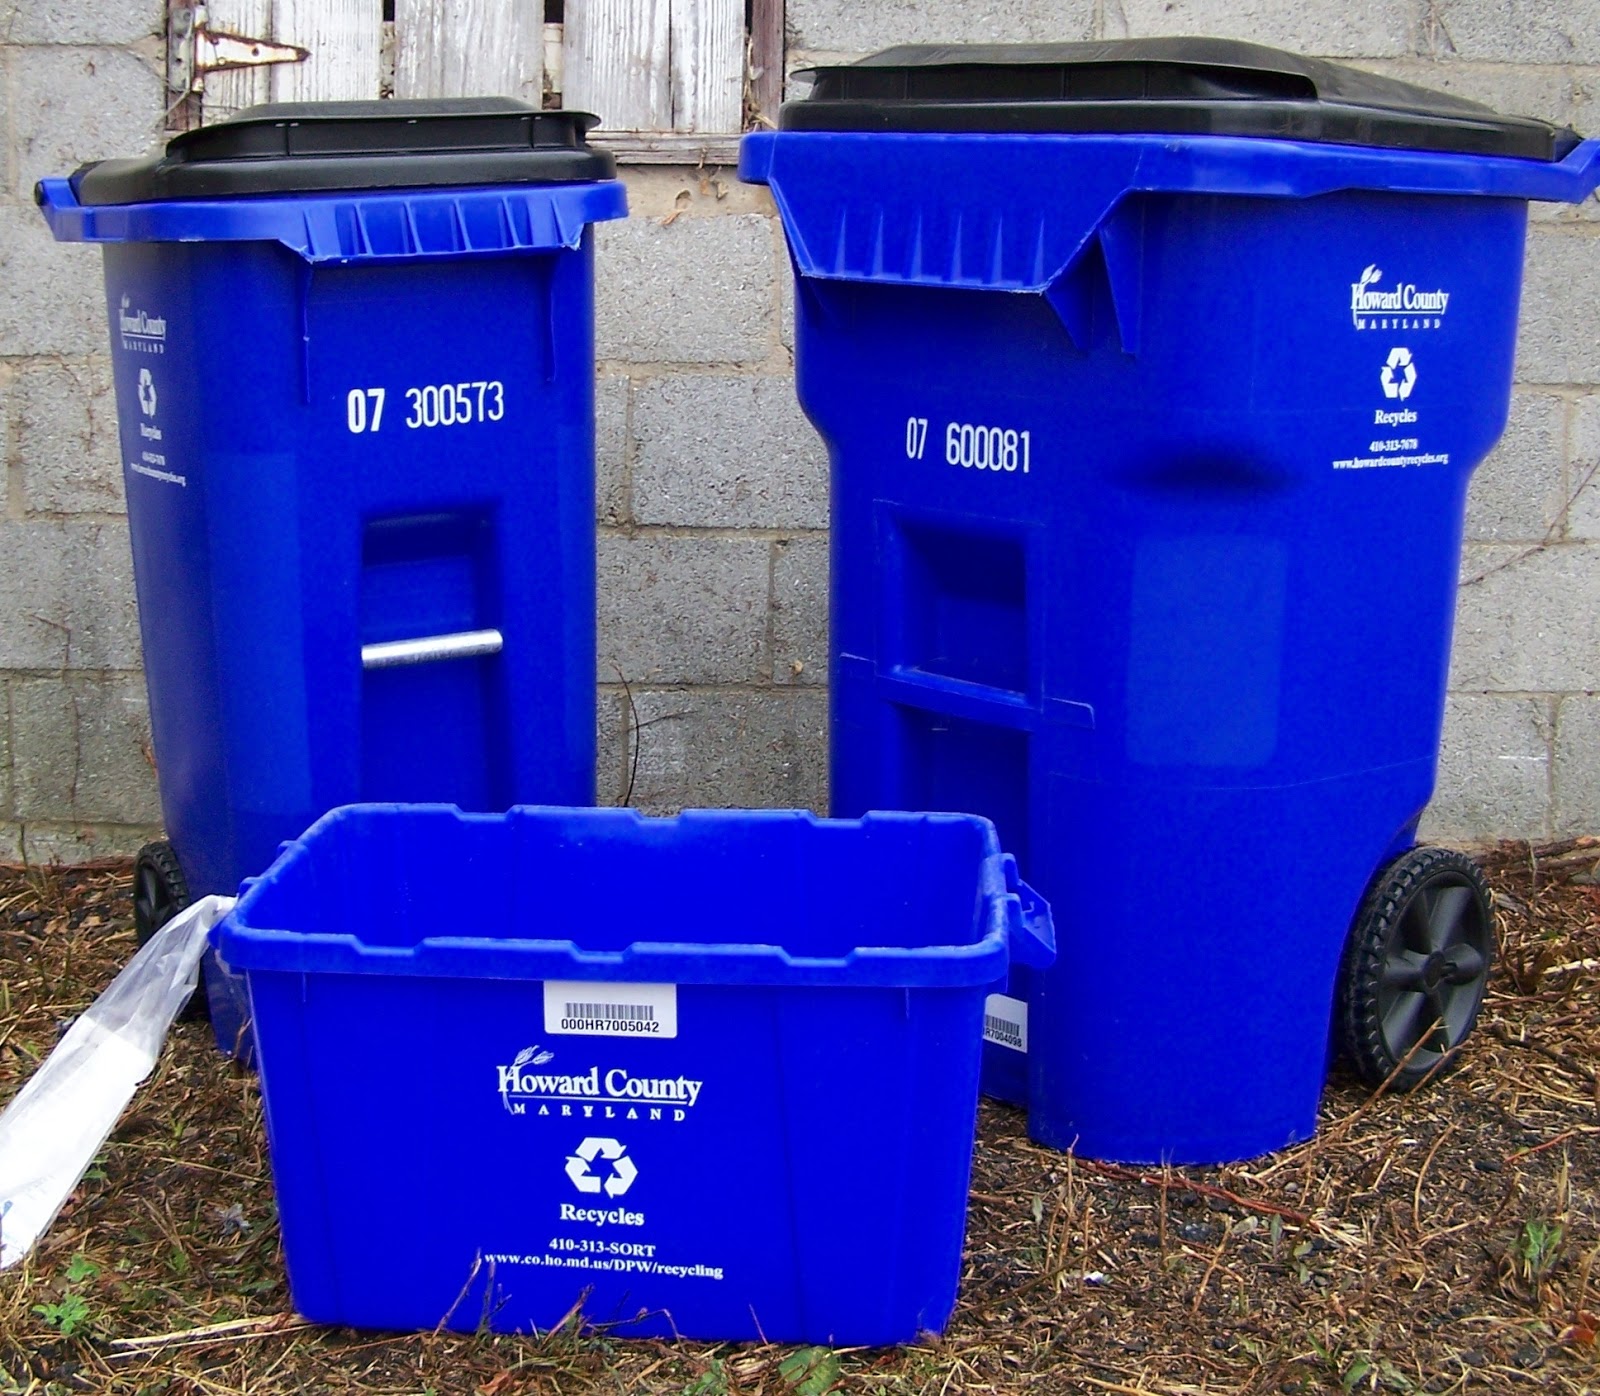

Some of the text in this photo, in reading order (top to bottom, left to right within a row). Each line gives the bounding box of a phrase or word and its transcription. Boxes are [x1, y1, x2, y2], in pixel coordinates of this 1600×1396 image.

[1351, 282, 1450, 315] Howard County
[1358, 318, 1441, 330] MARYLAND
[347, 381, 504, 433] 07 300573
[1374, 408, 1418, 427] Recycles
[906, 416, 1030, 473] 07 600081
[561, 1018, 660, 1033] 000HR7005042
[982, 1026, 1022, 1048] R7004098
[496, 1066, 703, 1107] Howard County
[512, 1103, 686, 1122] MARYLAND
[560, 1203, 645, 1226] Recycles
[549, 1238, 656, 1257] 410-313-SORT
[484, 1254, 724, 1280] www.co.ho.md.us/DPW/recycling
